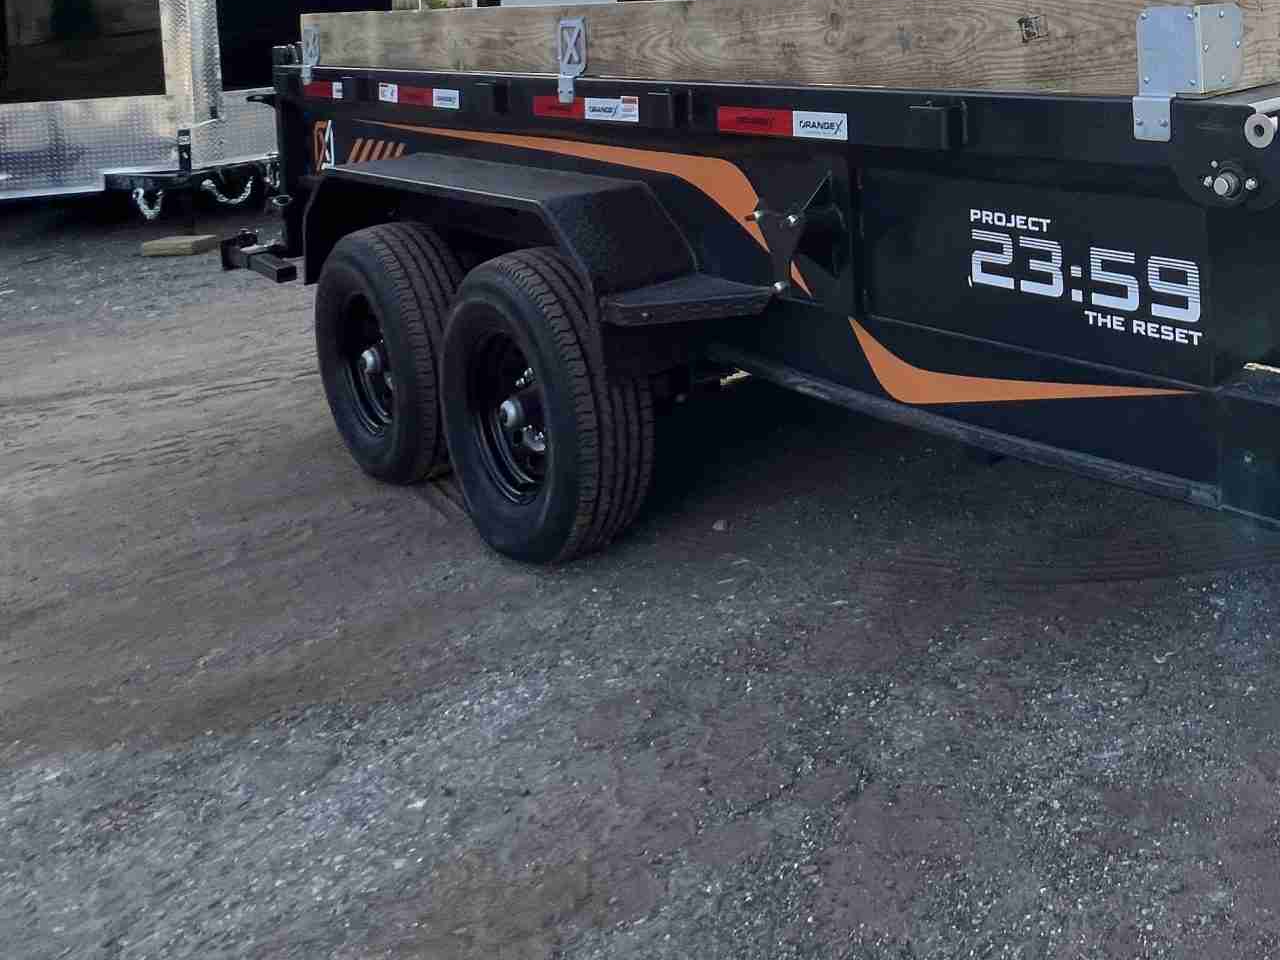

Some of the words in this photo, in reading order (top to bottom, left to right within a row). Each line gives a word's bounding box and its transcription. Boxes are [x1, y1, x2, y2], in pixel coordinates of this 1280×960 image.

[969, 208, 1051, 233] PROJECT
[970, 228, 1202, 323] 23:59
[1084, 310, 1126, 332] THE
[1132, 319, 1203, 346] RESET
